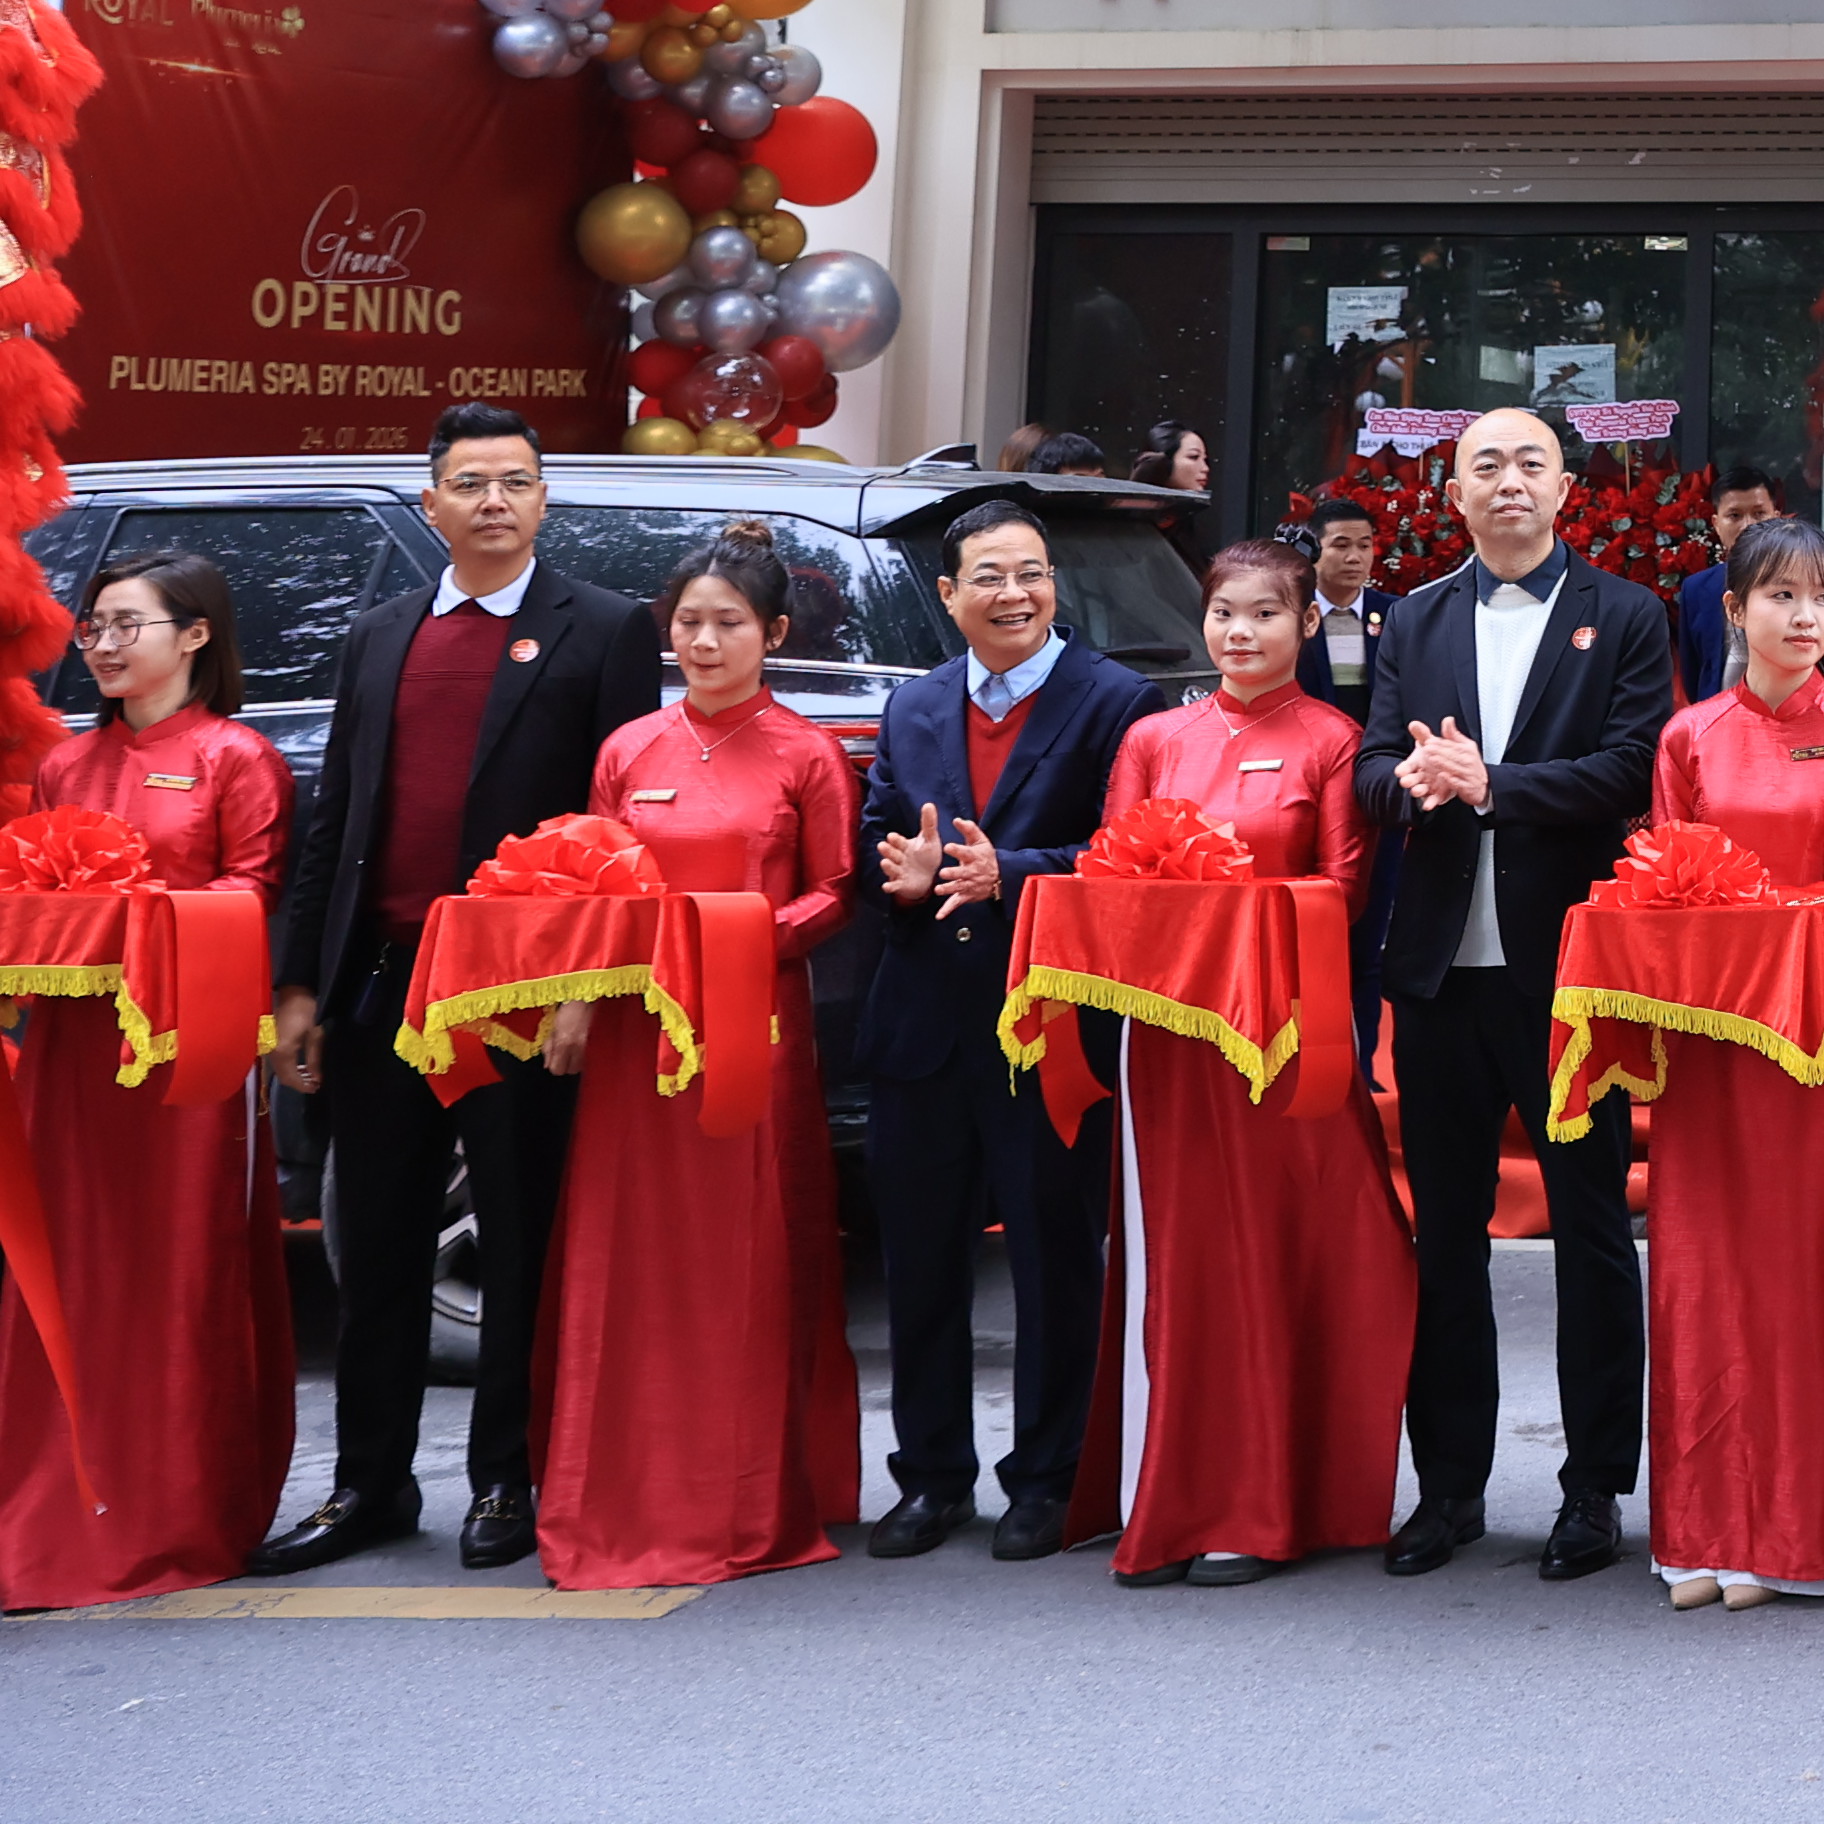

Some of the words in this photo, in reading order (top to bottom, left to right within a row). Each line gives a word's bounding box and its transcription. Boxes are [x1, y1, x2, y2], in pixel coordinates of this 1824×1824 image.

[251, 277, 463, 336] OPENING
[108, 355, 255, 394] PLUMERIA
[261, 361, 312, 396] SPA
[316, 363, 349, 397] BY
[354, 365, 432, 397] ROYAL
[448, 366, 527, 398] OCEAN
[530, 368, 587, 398] PARK
